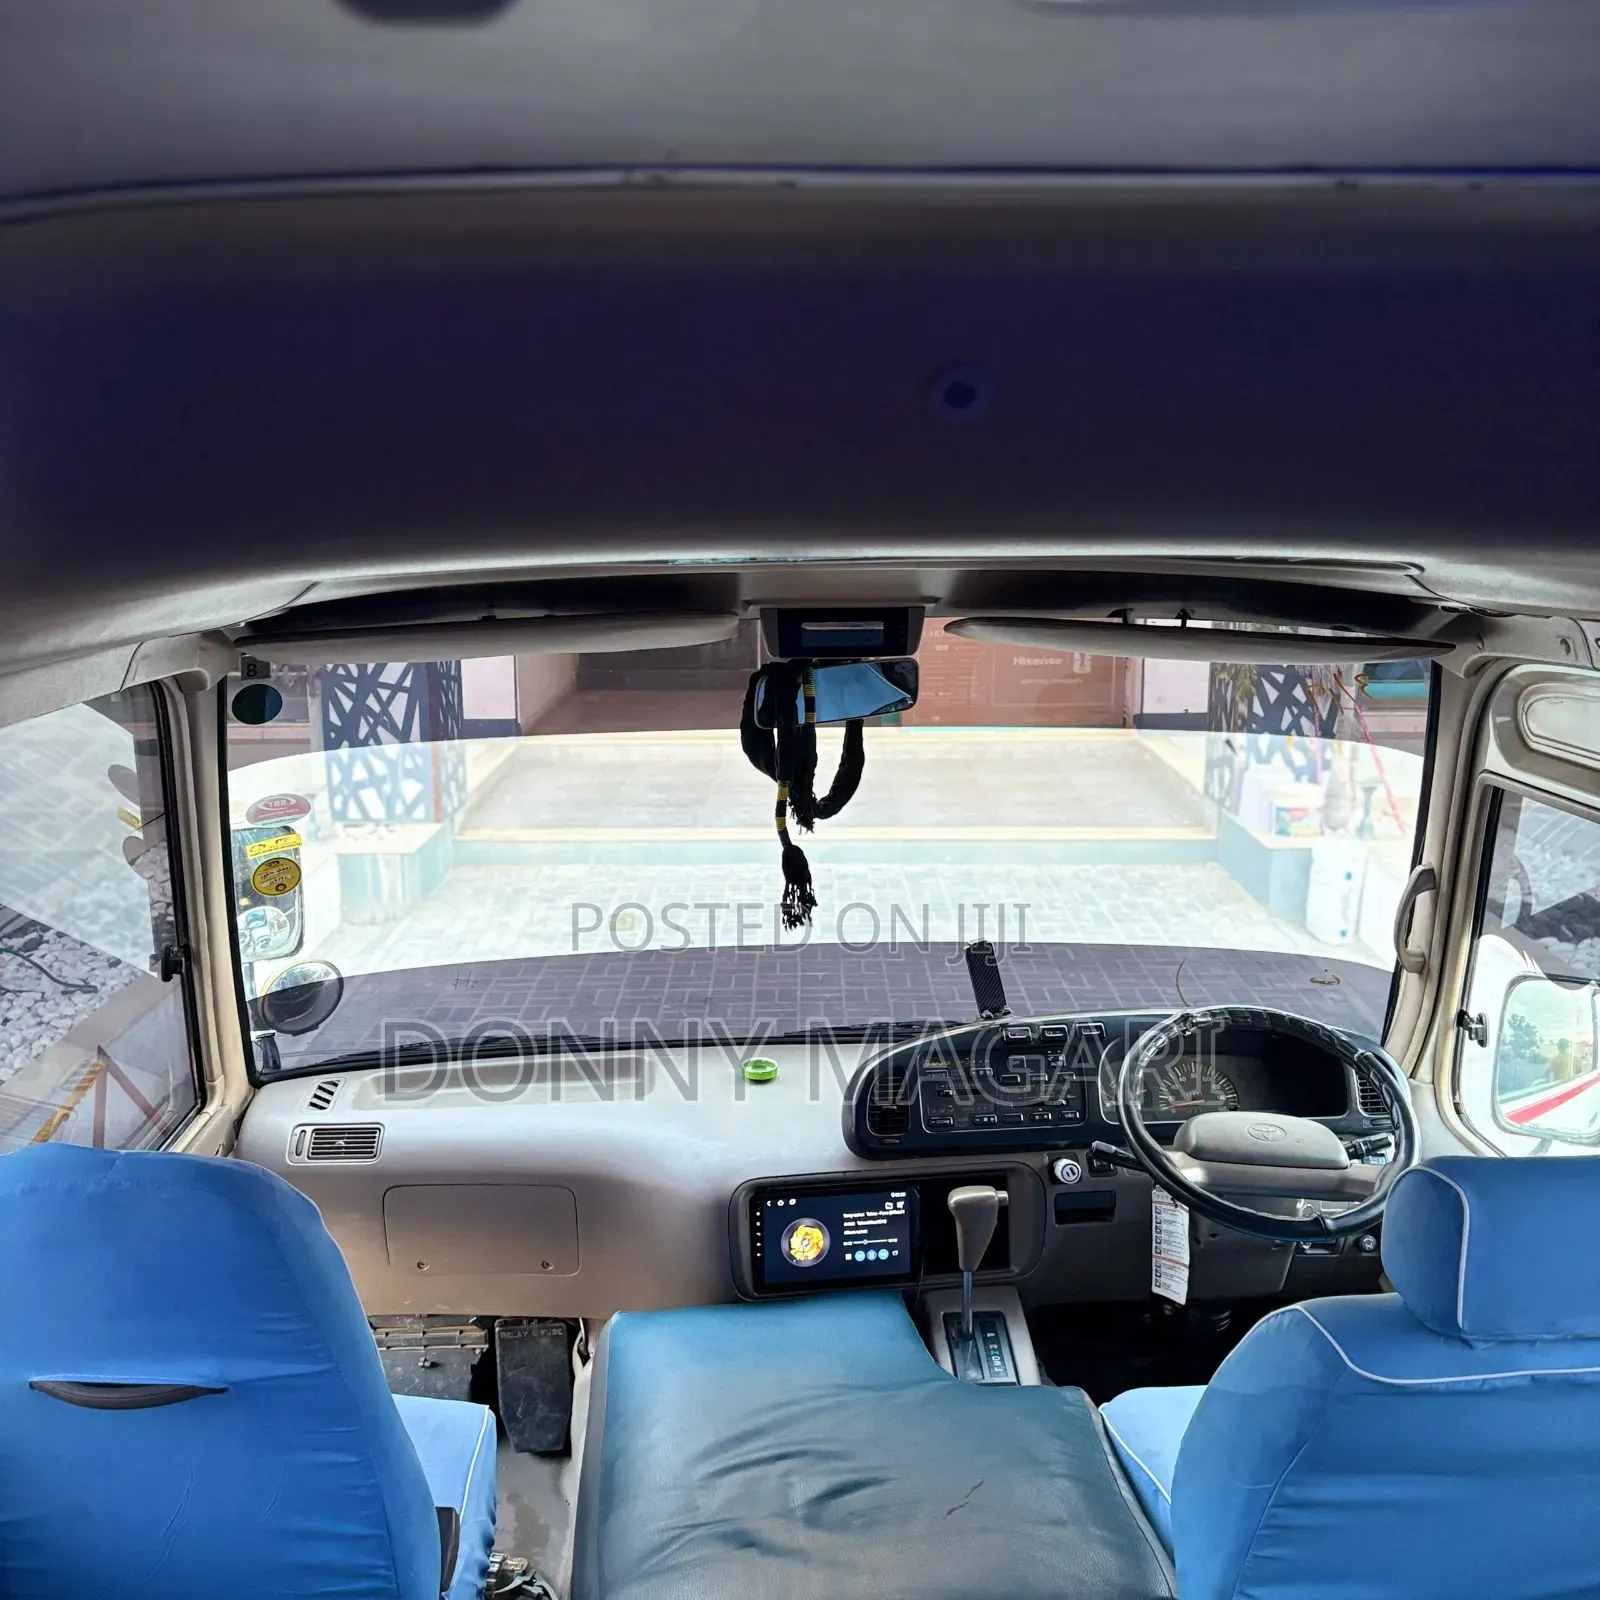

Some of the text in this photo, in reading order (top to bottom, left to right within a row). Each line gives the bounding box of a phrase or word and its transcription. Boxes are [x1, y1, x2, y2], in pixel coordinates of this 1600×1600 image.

[1012, 656, 1063, 667] Hisense
[500, 1331, 528, 1339] RELAY
[540, 1328, 564, 1336] FUSE
